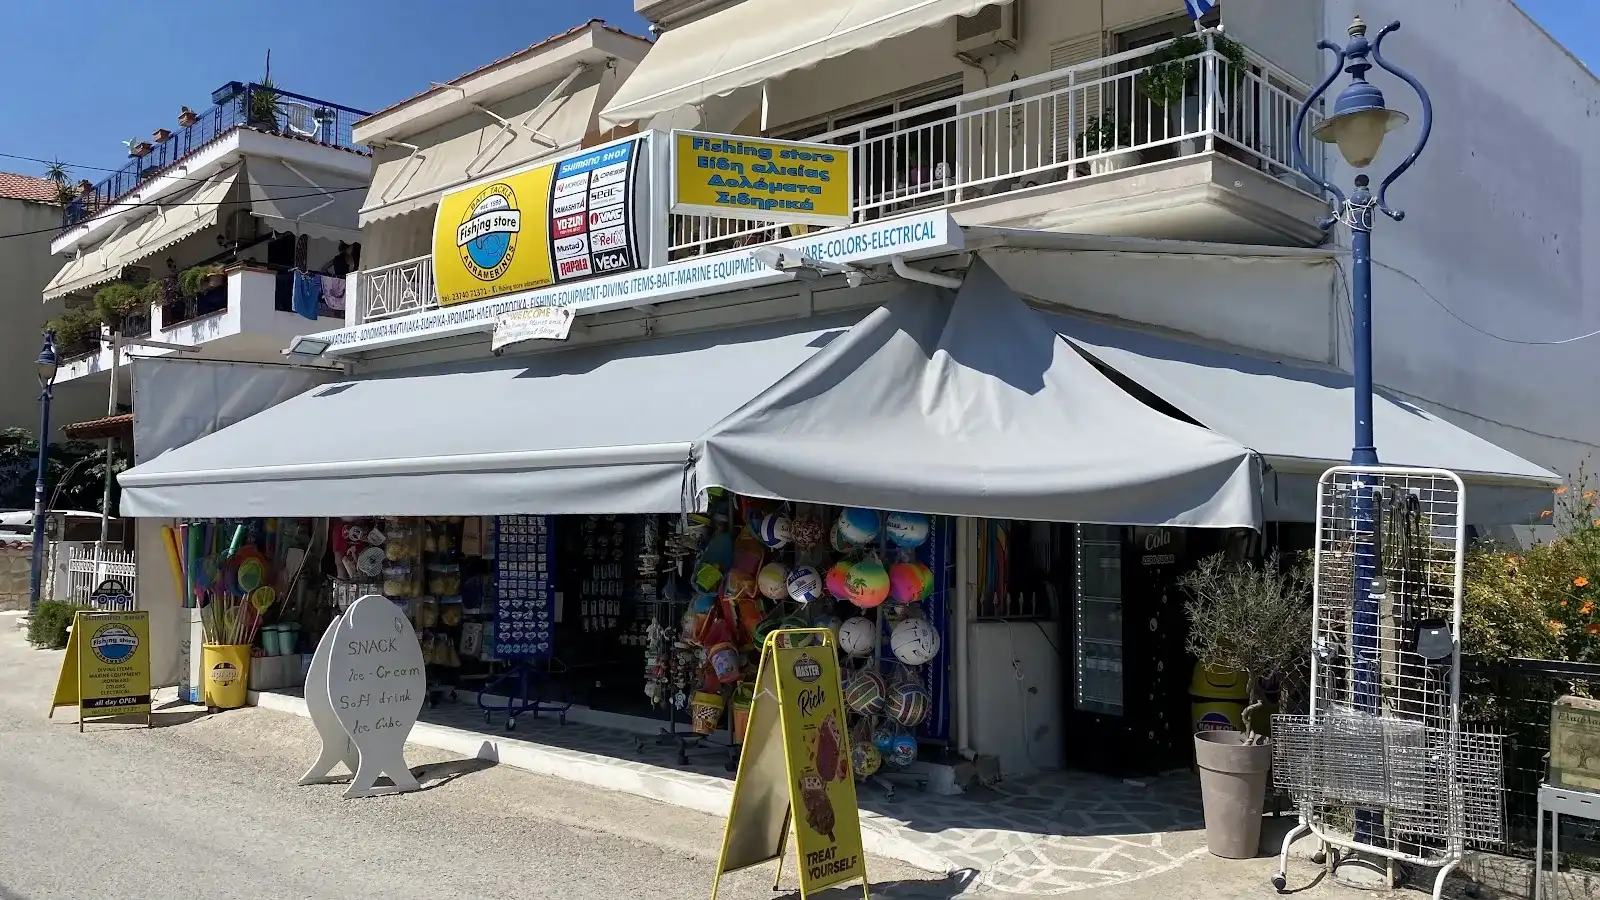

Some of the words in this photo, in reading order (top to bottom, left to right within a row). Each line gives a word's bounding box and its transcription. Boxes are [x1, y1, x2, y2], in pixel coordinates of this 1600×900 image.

[692, 138, 772, 159] Fishing
[780, 149, 834, 162] store
[562, 156, 600, 173] SHIMANO
[603, 148, 626, 162] SHOP
[698, 156, 743, 174] Είδη
[752, 162, 830, 182] αλιείας
[490, 186, 512, 200] TACKLE
[708, 174, 821, 194] Δολώματα
[554, 197, 584, 214] YAMASHITA
[716, 191, 814, 210] Σιδηρικά
[557, 215, 583, 230] YO-ZURI
[600, 207, 623, 223] VMC
[460, 218, 491, 240] Fishing
[494, 216, 516, 227] store
[557, 242, 580, 252] Mustad
[464, 245, 514, 279] ADRAMERINOS
[596, 252, 627, 270] VEGA
[630, 264, 712, 294] ITEMS-BAIT-MARINE
[452, 290, 468, 301] 23740
[470, 288, 488, 298] 71371
[1145, 528, 1170, 550] Cola
[1142, 554, 1156, 565] ZERO
[94, 638, 117, 646] Fishing
[348, 638, 398, 656] SNACK
[795, 664, 820, 678] MASTER
[340, 694, 371, 710] Soft
[378, 689, 412, 704] drink
[798, 685, 826, 718] Rich
[1558, 712, 1600, 726] Ελαιόλα
[806, 846, 838, 866] TREAT
[808, 855, 858, 882] YOURSELF
